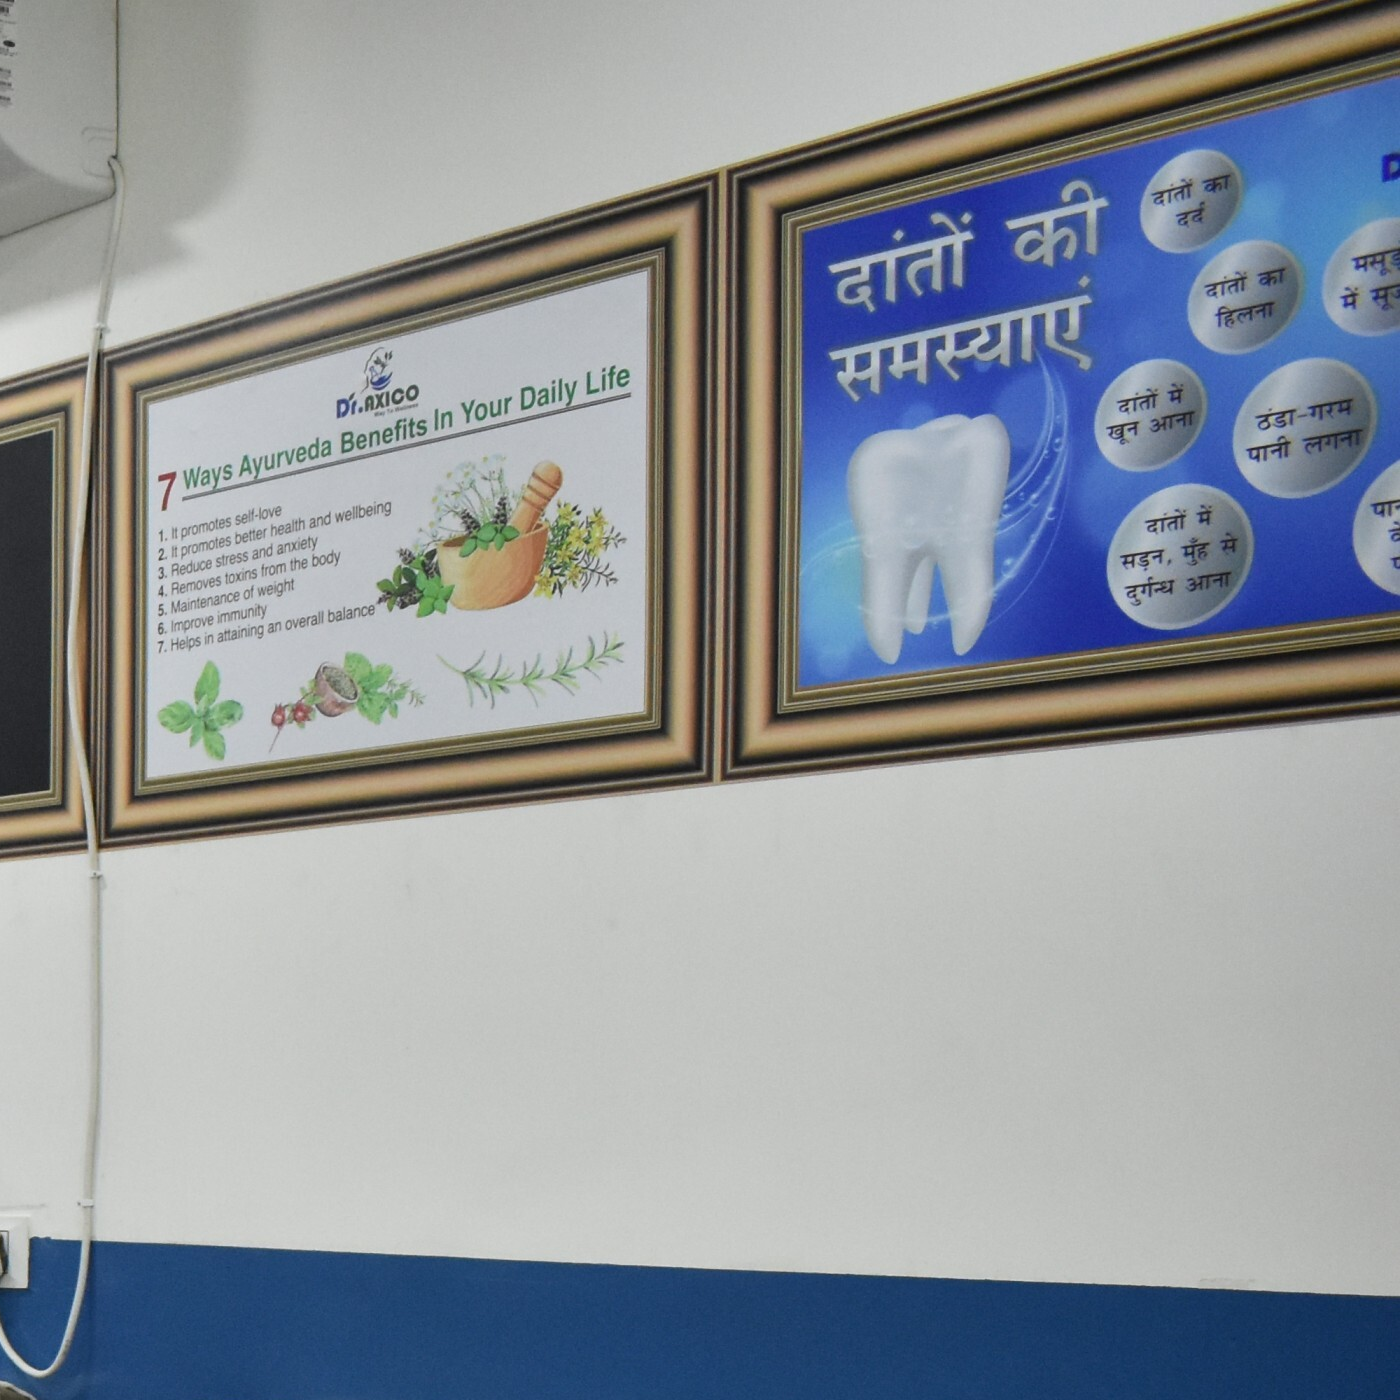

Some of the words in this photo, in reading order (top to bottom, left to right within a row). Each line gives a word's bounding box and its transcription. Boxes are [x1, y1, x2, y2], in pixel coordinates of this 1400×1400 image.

[1152, 178, 1194, 206] दांतों
[1203, 174, 1231, 193] का
[1176, 201, 1206, 227] दर्द
[828, 212, 974, 312] दांतों
[1005, 180, 1109, 267] की
[1205, 271, 1247, 299] दांतों
[1258, 267, 1287, 287] का
[1340, 287, 1360, 310] में
[1215, 302, 1276, 328] हिलना
[829, 275, 1093, 402] समस्याएं
[1117, 388, 1159, 415] दांतों
[1167, 383, 1184, 405] में
[1255, 399, 1353, 432] ठंडा-गरम
[157, 471, 177, 511] 7
[183, 464, 233, 490] Ways
[238, 437, 332, 479] Ayurveda
[340, 418, 427, 454] Benefits
[434, 408, 453, 431] In
[461, 396, 512, 424] Your
[520, 378, 577, 411] Daily
[585, 365, 631, 396] Life
[1106, 420, 1140, 445] खून
[1150, 410, 1196, 433] आना
[1246, 435, 1292, 463] पानी
[1302, 429, 1363, 455] लगना
[158, 529, 168, 542] 1.
[171, 527, 178, 539] It
[181, 516, 232, 541] promotes
[235, 505, 282, 524] self-love
[158, 548, 168, 561] 2.
[171, 545, 178, 558] It
[181, 535, 232, 559] promotes
[235, 527, 268, 545] better
[270, 518, 306, 537] health
[309, 512, 332, 529] and
[335, 501, 392, 524] wellbeing
[1145, 509, 1187, 535] दांतों
[1197, 505, 1212, 526] में
[158, 567, 167, 580] 3.
[171, 555, 213, 577] Reduce
[215, 551, 249, 568] stress
[252, 543, 273, 560] and
[276, 535, 319, 555] anxiety
[1120, 549, 1173, 572] सड़न,
[1182, 537, 1210, 566] मुँह
[1220, 533, 1238, 553] से
[158, 585, 167, 597] 4.
[171, 575, 222, 596] Removes
[225, 567, 258, 585] toxins
[261, 562, 286, 577] from
[290, 557, 308, 572] the
[311, 550, 341, 567] body
[1125, 577, 1176, 606] दुर्गन्ध
[1186, 571, 1233, 592] आना
[158, 604, 167, 617] 5.
[171, 591, 240, 614] Maintenance
[243, 586, 254, 599] of
[257, 578, 295, 598] weight
[157, 641, 167, 654] 7.
[171, 634, 201, 652] Helps
[204, 632, 214, 645] in
[217, 623, 265, 644] attaining
[267, 621, 282, 634] an
[285, 610, 324, 631] overall
[327, 604, 376, 623] balance
[158, 622, 167, 635] 6.
[171, 615, 214, 634] Improve
[217, 604, 267, 624] immunity
